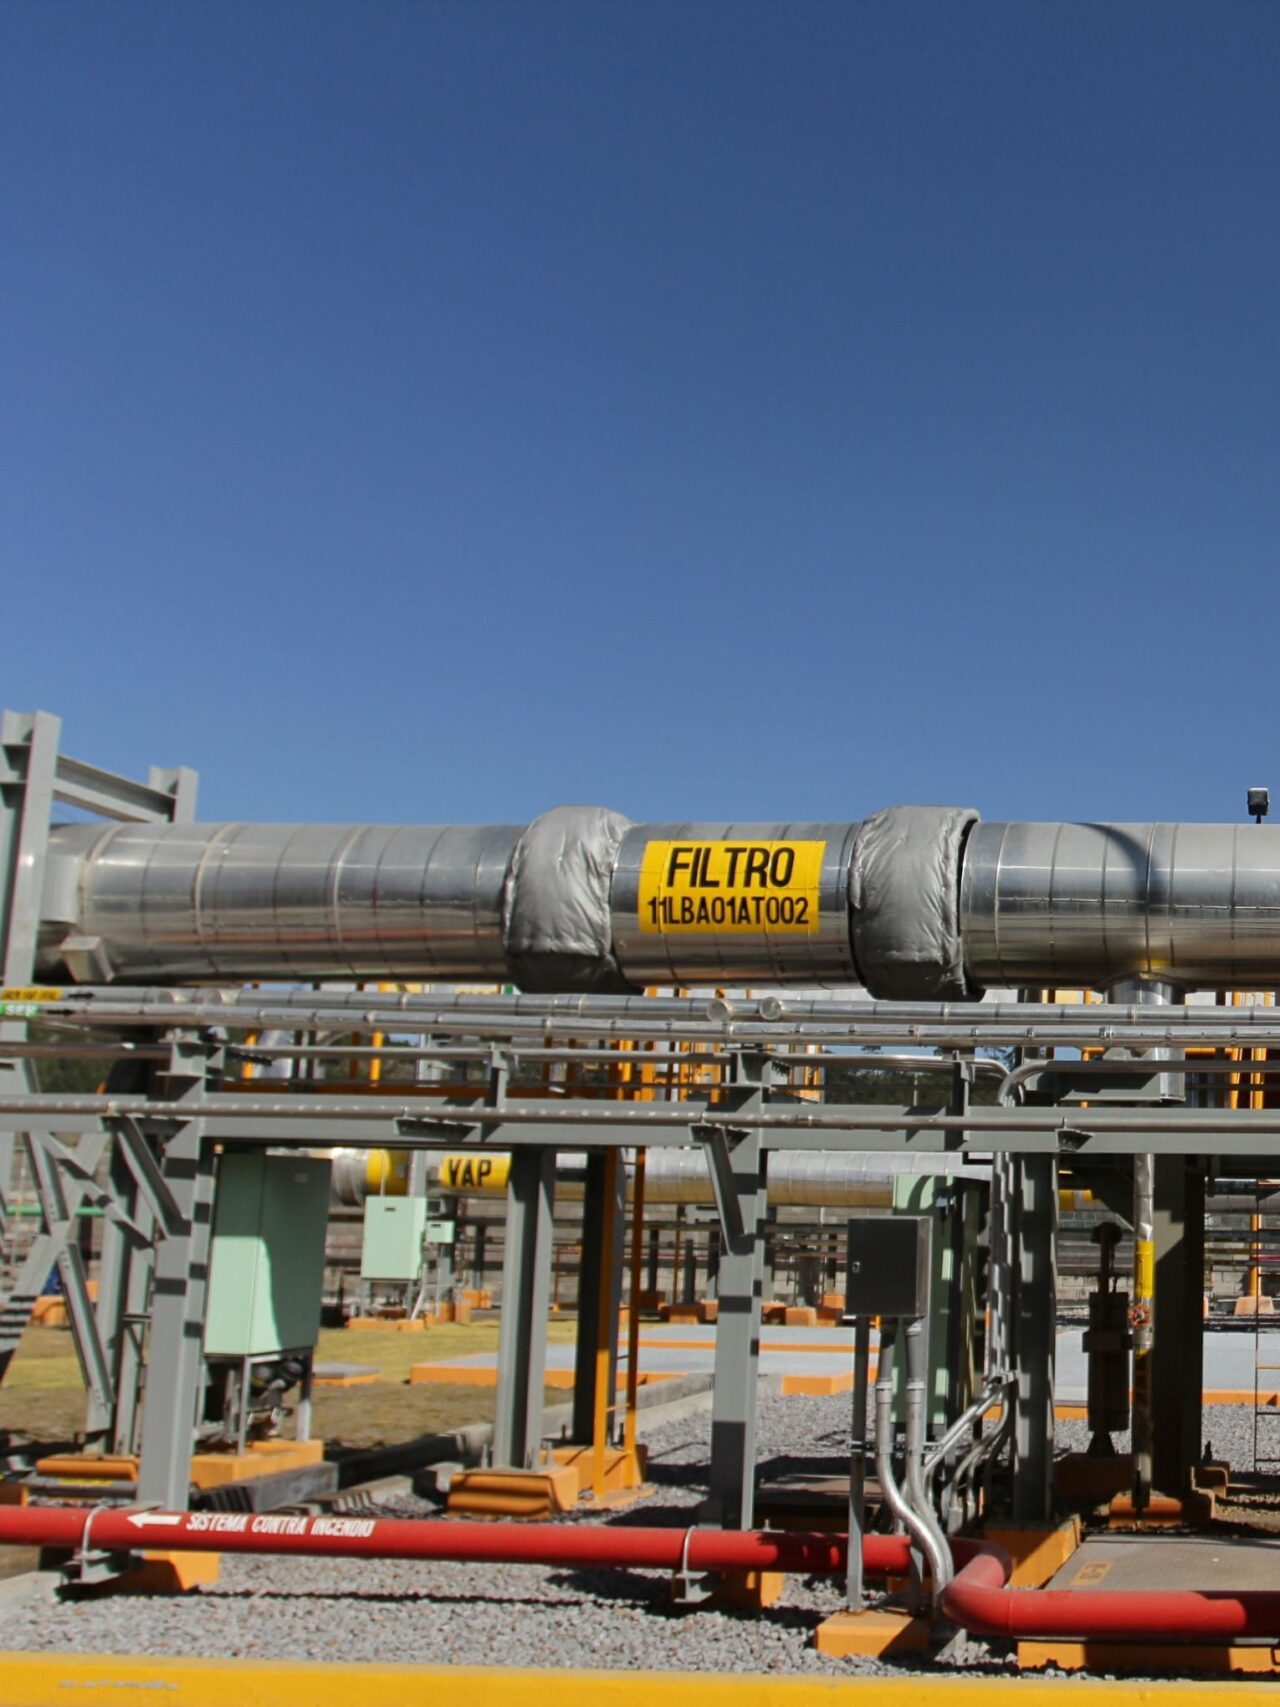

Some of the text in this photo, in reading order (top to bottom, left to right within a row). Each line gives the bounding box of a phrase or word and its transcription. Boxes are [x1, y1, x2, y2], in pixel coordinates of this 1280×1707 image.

[666, 847, 795, 888] FILTRO
[648, 896, 809, 925] 11LBA01AT002
[448, 1158, 492, 1187] VAP
[186, 1512, 376, 1538] SISTEMA CONTRA INCENDIO
